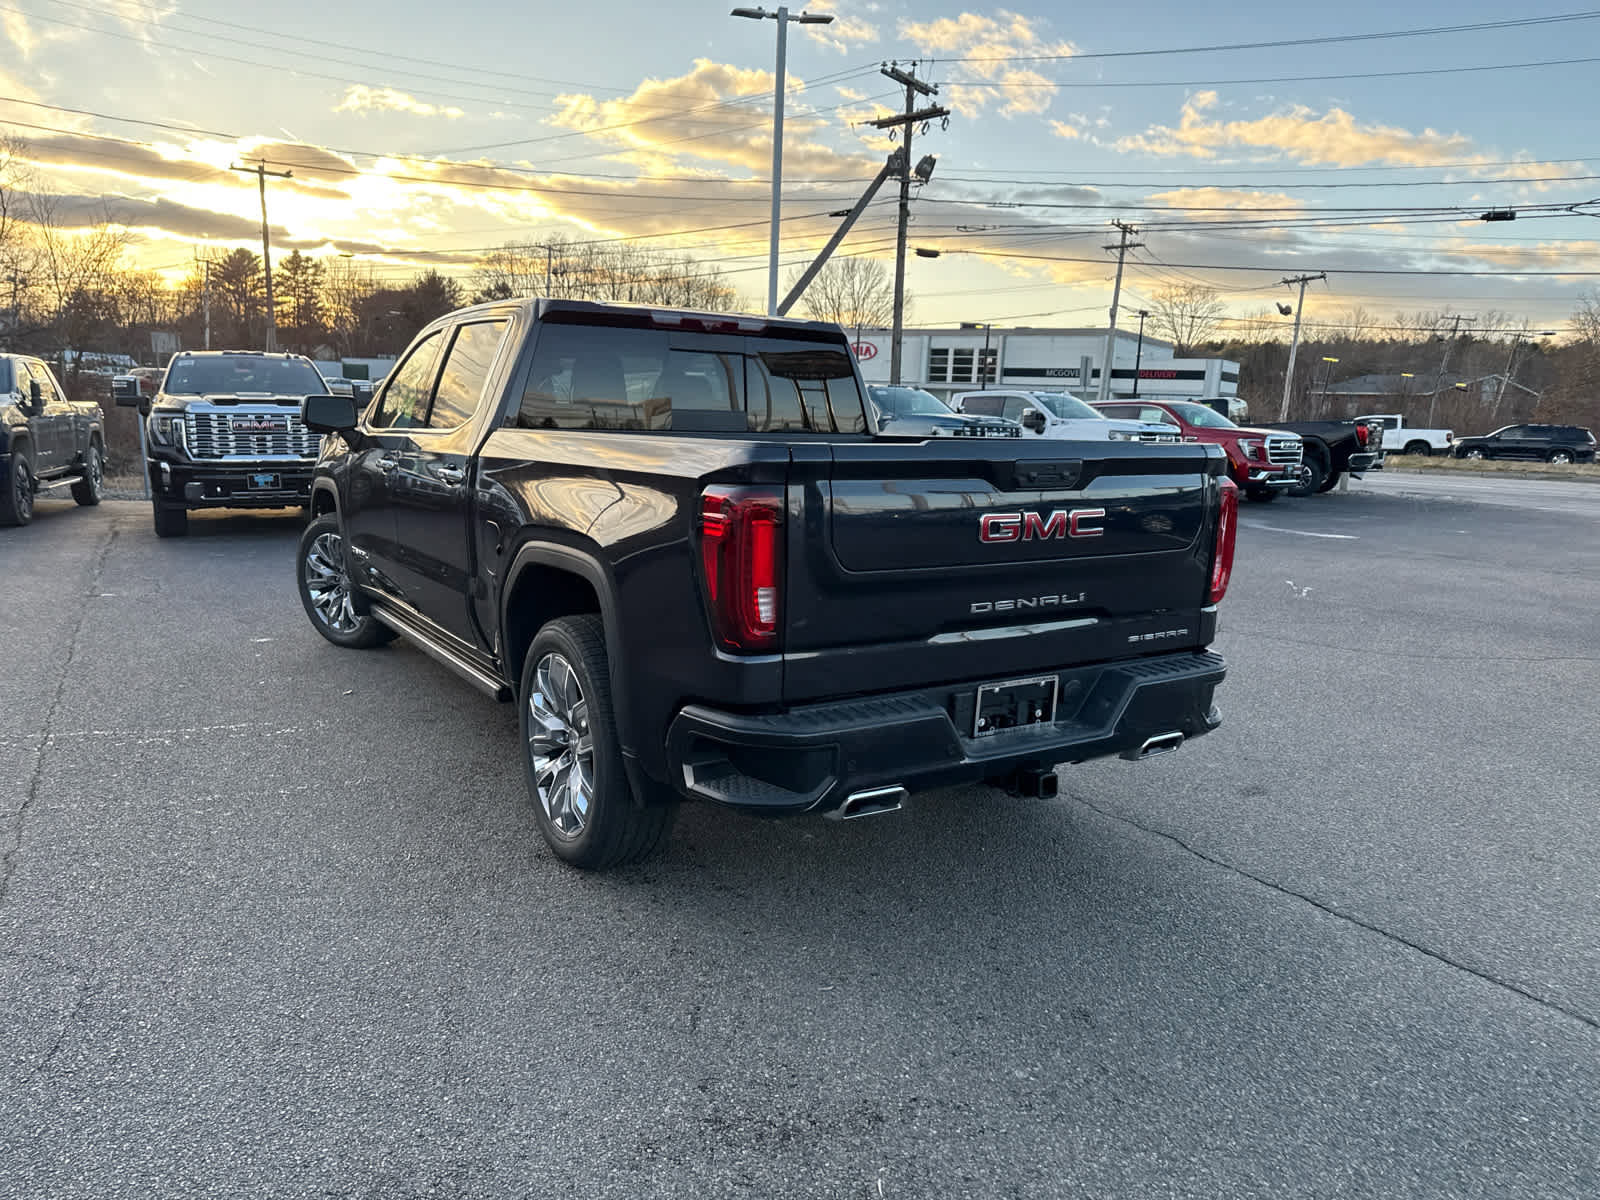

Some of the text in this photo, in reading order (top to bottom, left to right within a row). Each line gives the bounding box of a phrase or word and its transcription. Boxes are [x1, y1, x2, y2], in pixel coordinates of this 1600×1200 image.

[1046, 368, 1080, 377] MCGOVE
[1140, 370, 1176, 378] DELIVERY
[980, 508, 1105, 543] GMC
[970, 592, 1086, 613] DENALI
[1127, 628, 1188, 642] SIERRA
